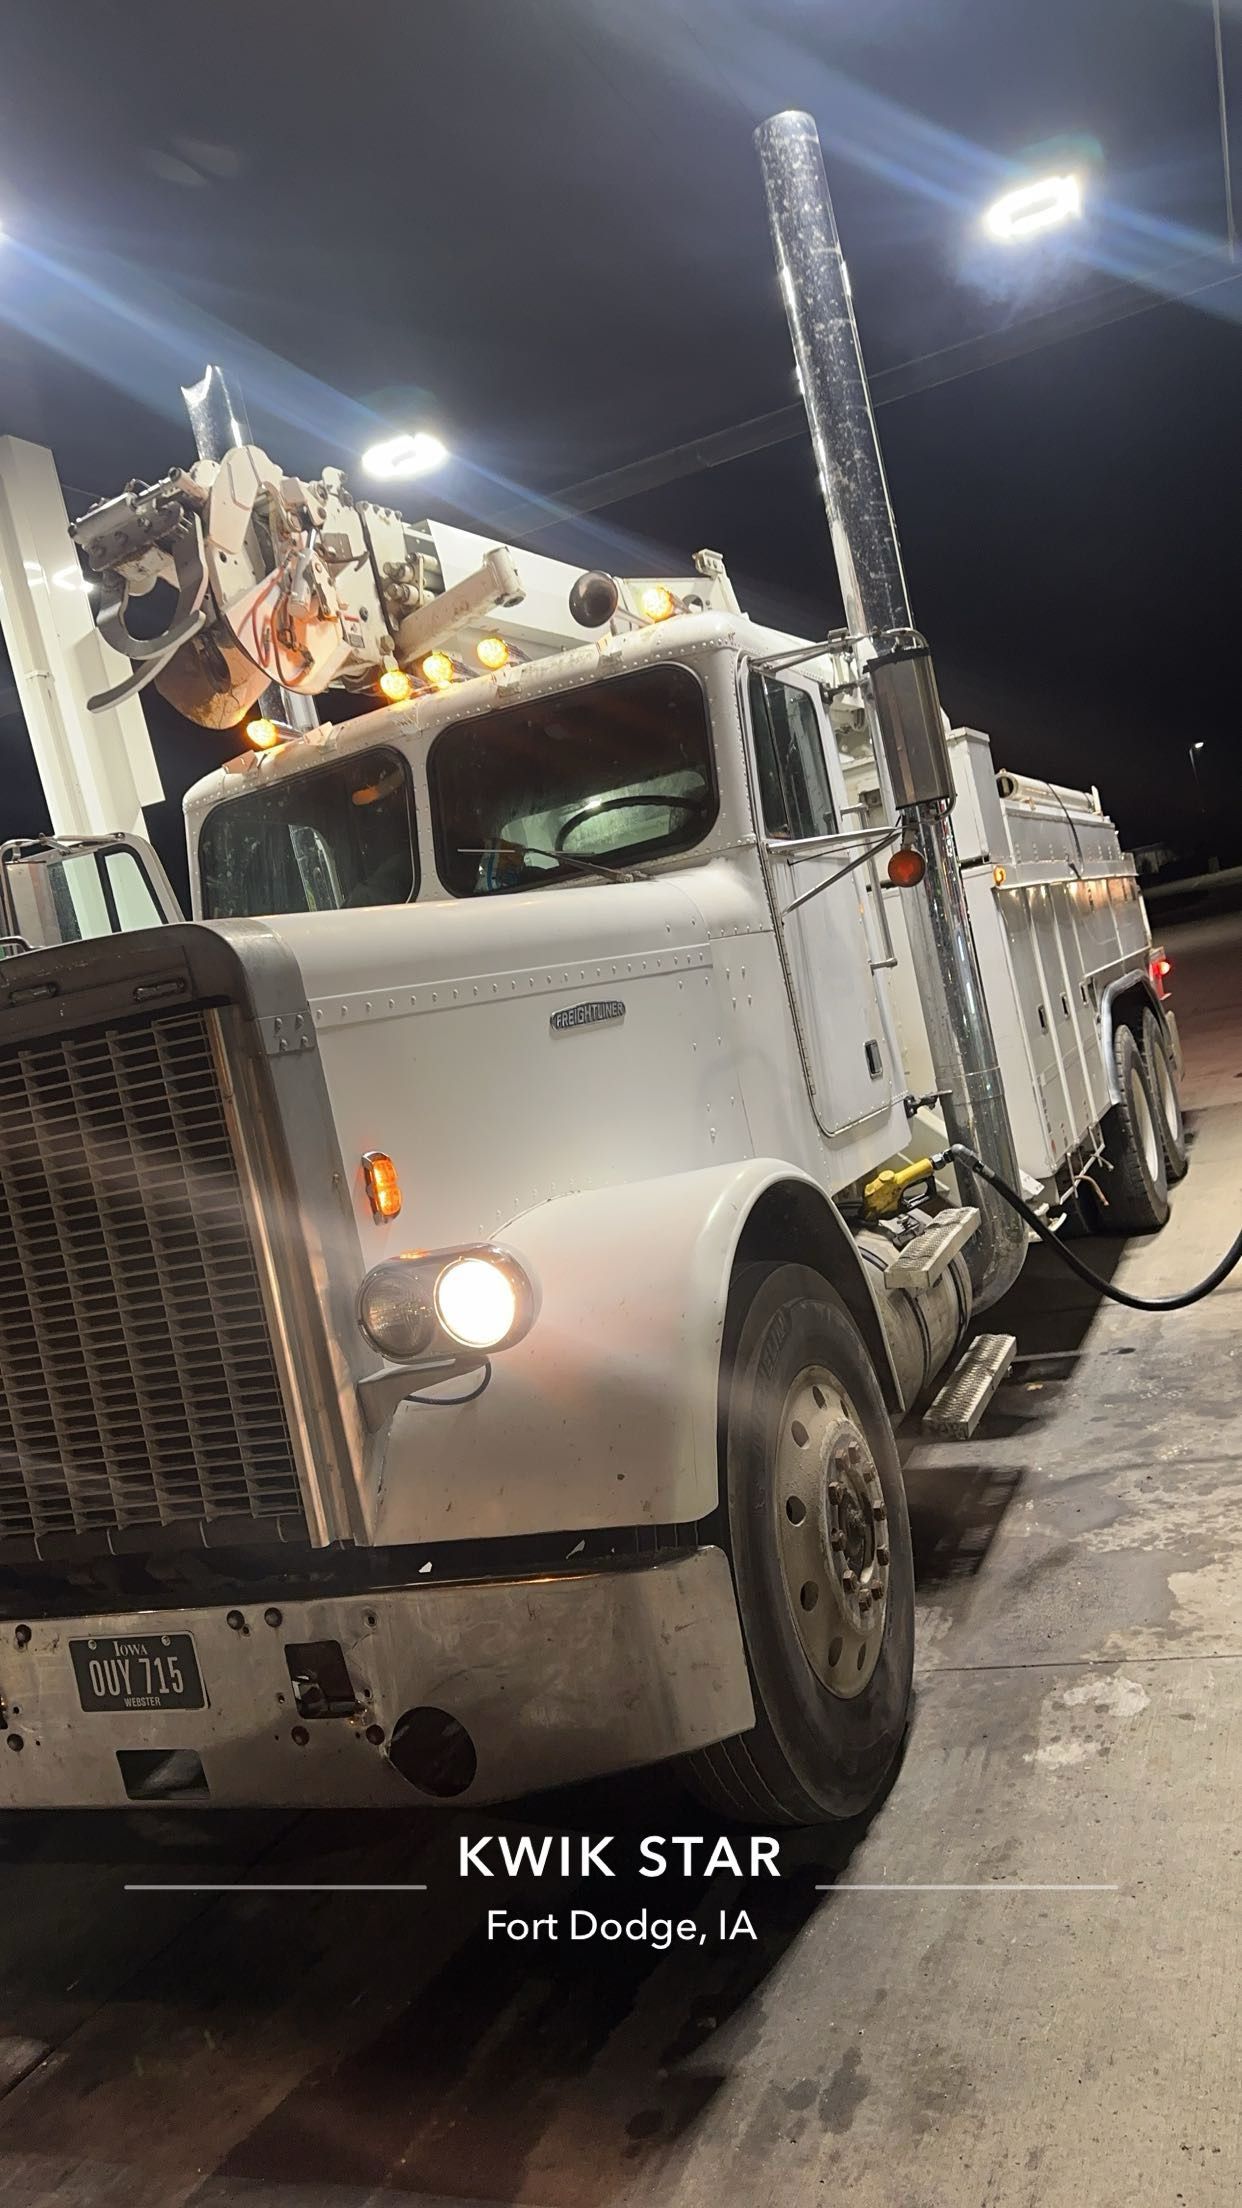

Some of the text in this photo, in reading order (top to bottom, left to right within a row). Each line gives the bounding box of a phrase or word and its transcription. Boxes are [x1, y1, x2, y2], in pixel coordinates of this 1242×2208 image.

[556, 1002, 624, 1027] FREIGHTLINER
[138, 1656, 184, 1695] 715
[123, 1696, 161, 1707] WEBSTER
